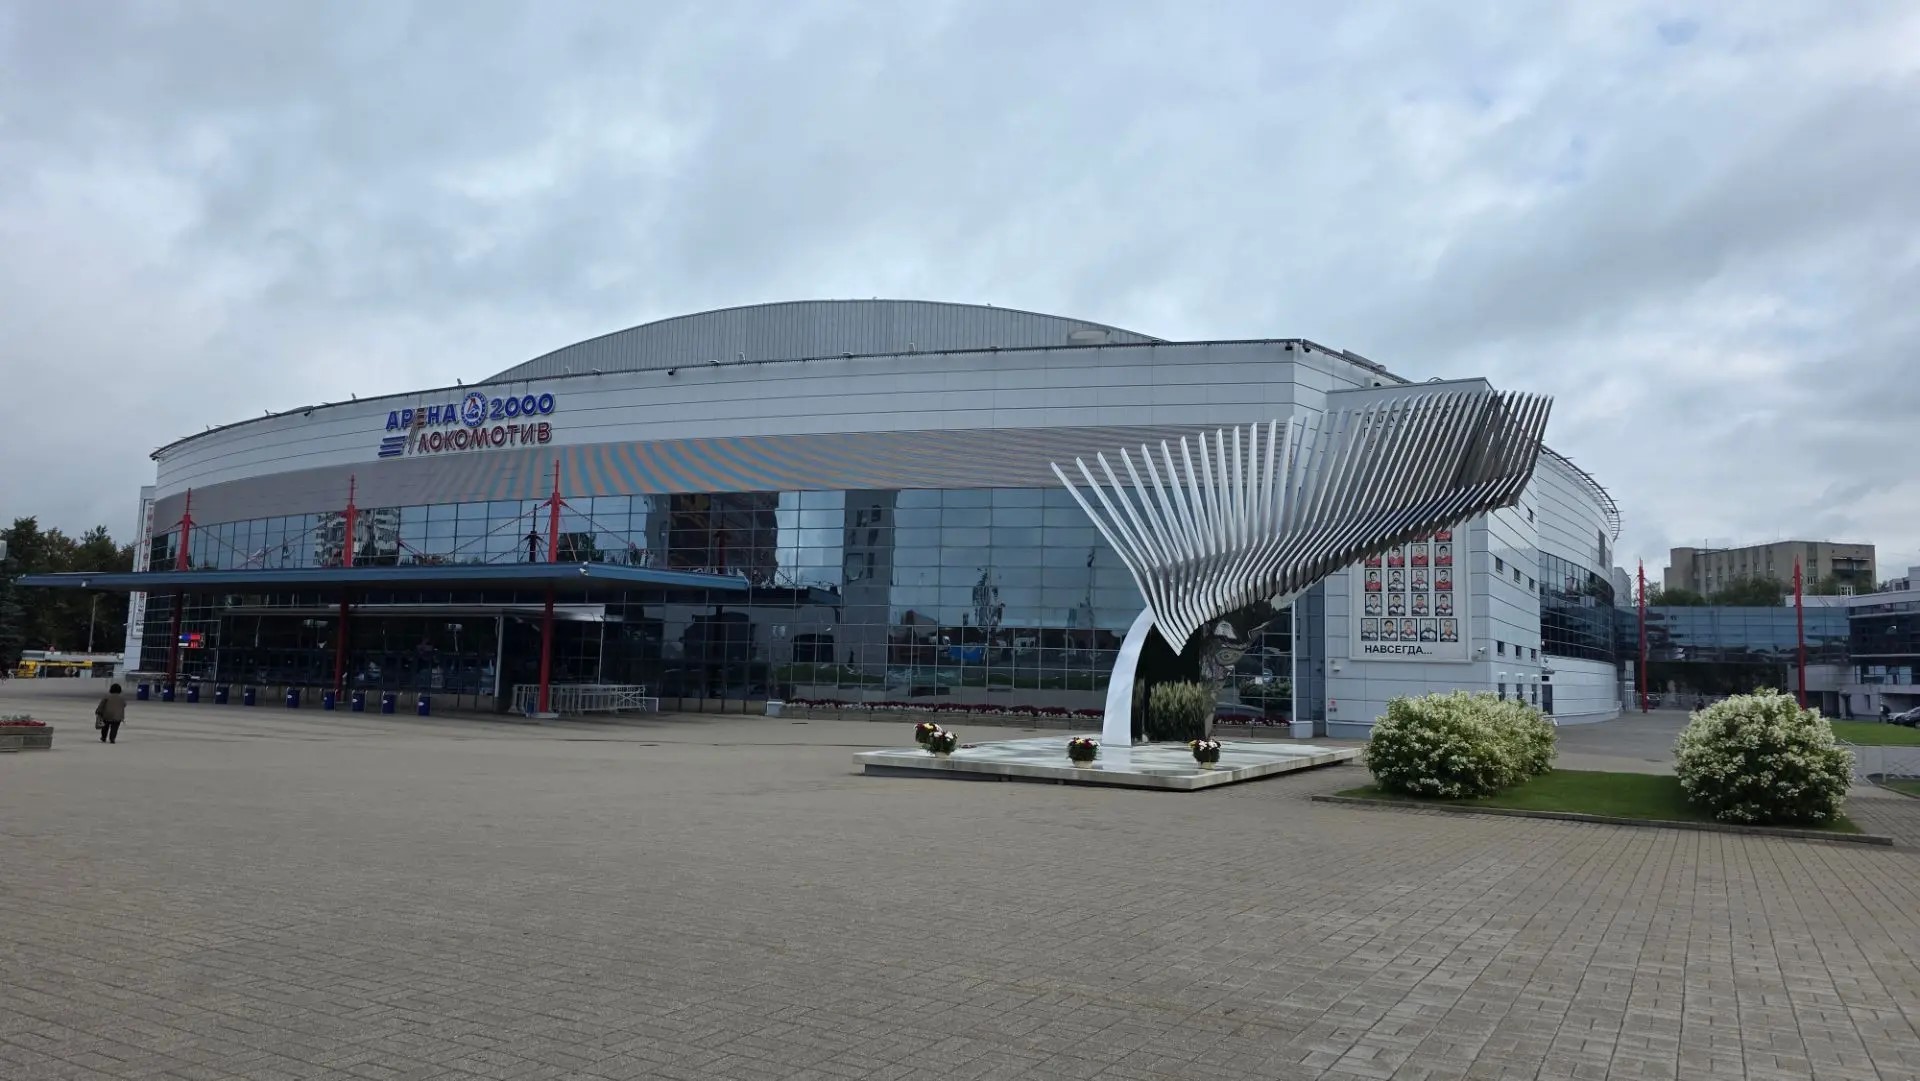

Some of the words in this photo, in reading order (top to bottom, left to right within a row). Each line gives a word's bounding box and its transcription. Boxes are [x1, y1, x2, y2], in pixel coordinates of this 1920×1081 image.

[385, 404, 458, 431] АРЕНА
[489, 392, 555, 421] 2000
[417, 422, 551, 453] ЛОКОМОТИВ
